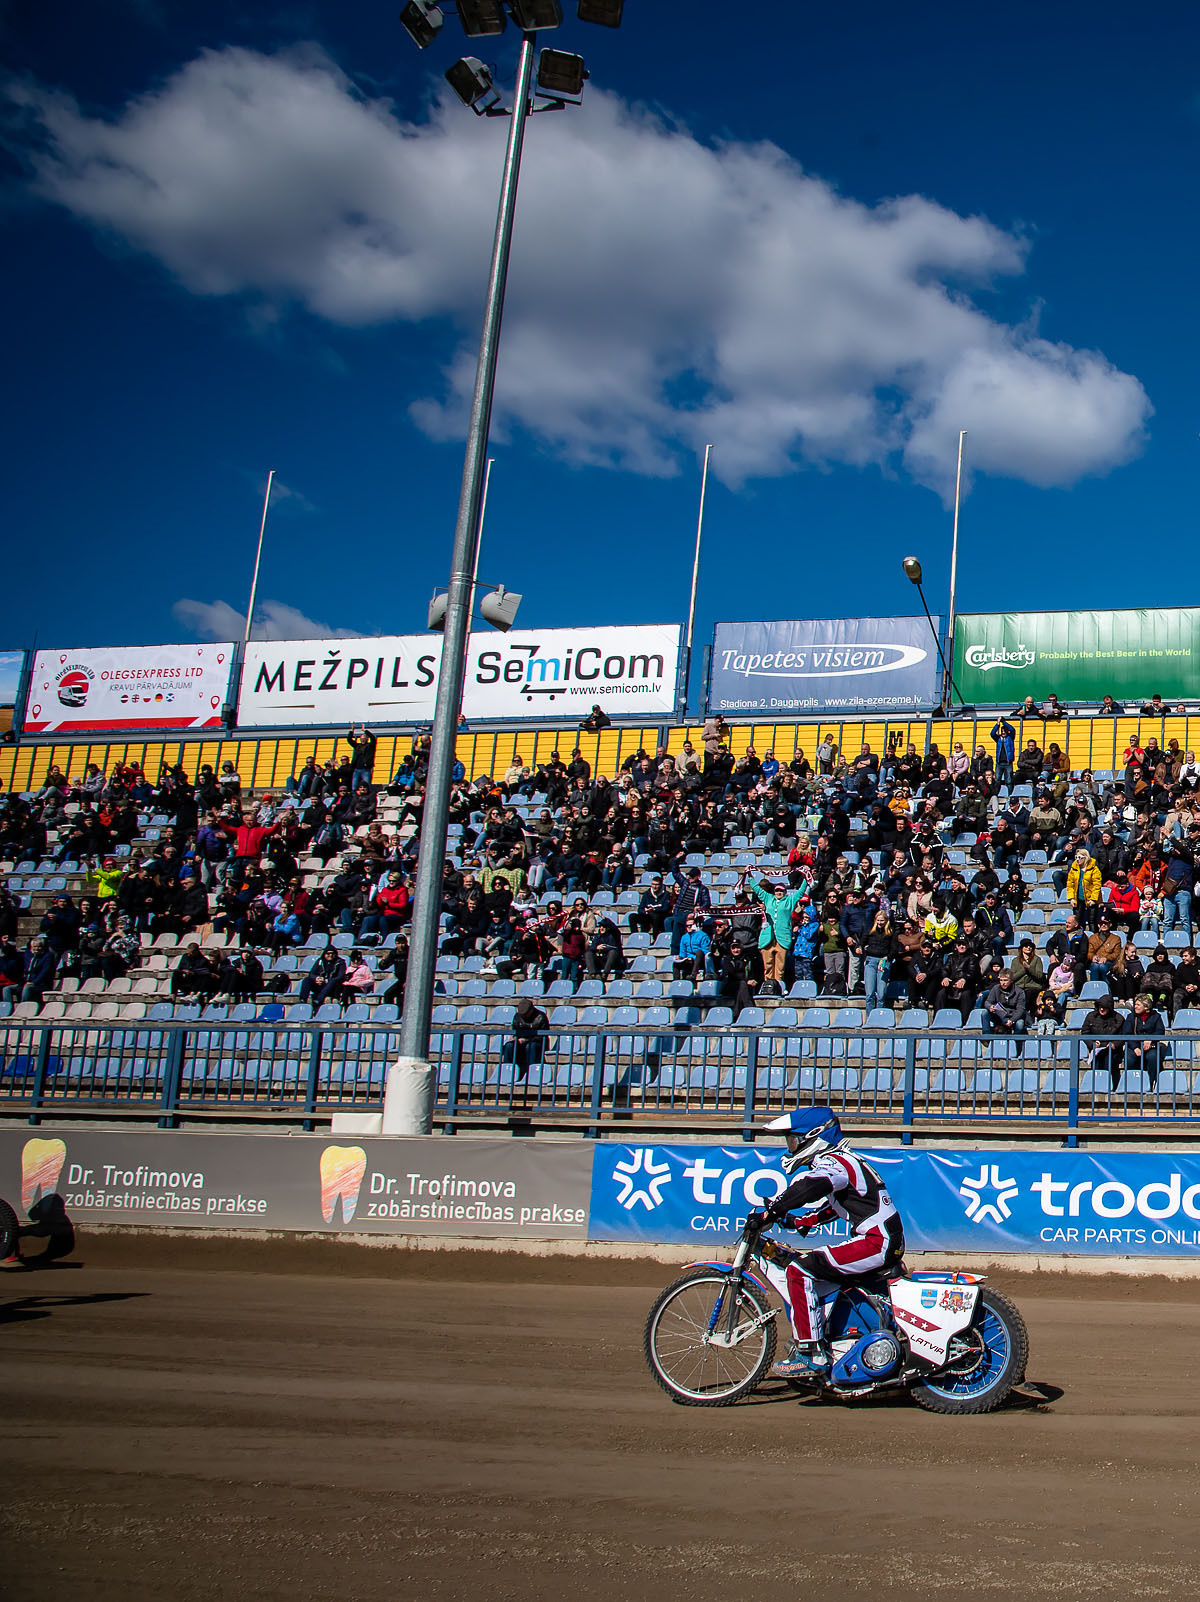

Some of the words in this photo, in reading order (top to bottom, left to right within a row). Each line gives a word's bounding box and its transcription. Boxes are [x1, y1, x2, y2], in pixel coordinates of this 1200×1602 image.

[475, 647, 665, 685] SemiCom
[721, 649, 807, 677] Tapetes
[812, 648, 885, 668] visiem
[965, 644, 1036, 671] Carlsberg
[1039, 652, 1077, 660] Probably
[1079, 650, 1094, 658] the
[1096, 649, 1115, 658] Best
[1138, 649, 1148, 657] in
[1149, 649, 1163, 657] the
[1165, 648, 1191, 656] World
[100, 669, 181, 681] OLEGSEXPRESS
[185, 667, 204, 678] LTD
[254, 649, 437, 693] MEŽPILS
[109, 682, 135, 692] KRAVU
[570, 683, 661, 695] www.semicom.lv
[720, 699, 758, 709] Stadiona
[760, 698, 768, 708] 2,
[770, 697, 819, 709] Daugavpils
[824, 695, 922, 707] www.zila-ezerzeme.lv
[68, 1163, 96, 1186] Dr.
[102, 1164, 204, 1190] Trofimova
[370, 1171, 400, 1196] Dr.
[407, 1173, 516, 1199] Trofimova
[683, 1158, 830, 1208] tro
[65, 1189, 201, 1212] zobārstniecības
[206, 1195, 268, 1216] prakse
[367, 1199, 515, 1222] zobārstniecības
[519, 1206, 586, 1228] prakse
[690, 1215, 730, 1232] CAR
[1040, 1227, 1080, 1243] CAR
[1084, 1228, 1146, 1244] PARTS
[910, 1334, 945, 1355] LATVIA
